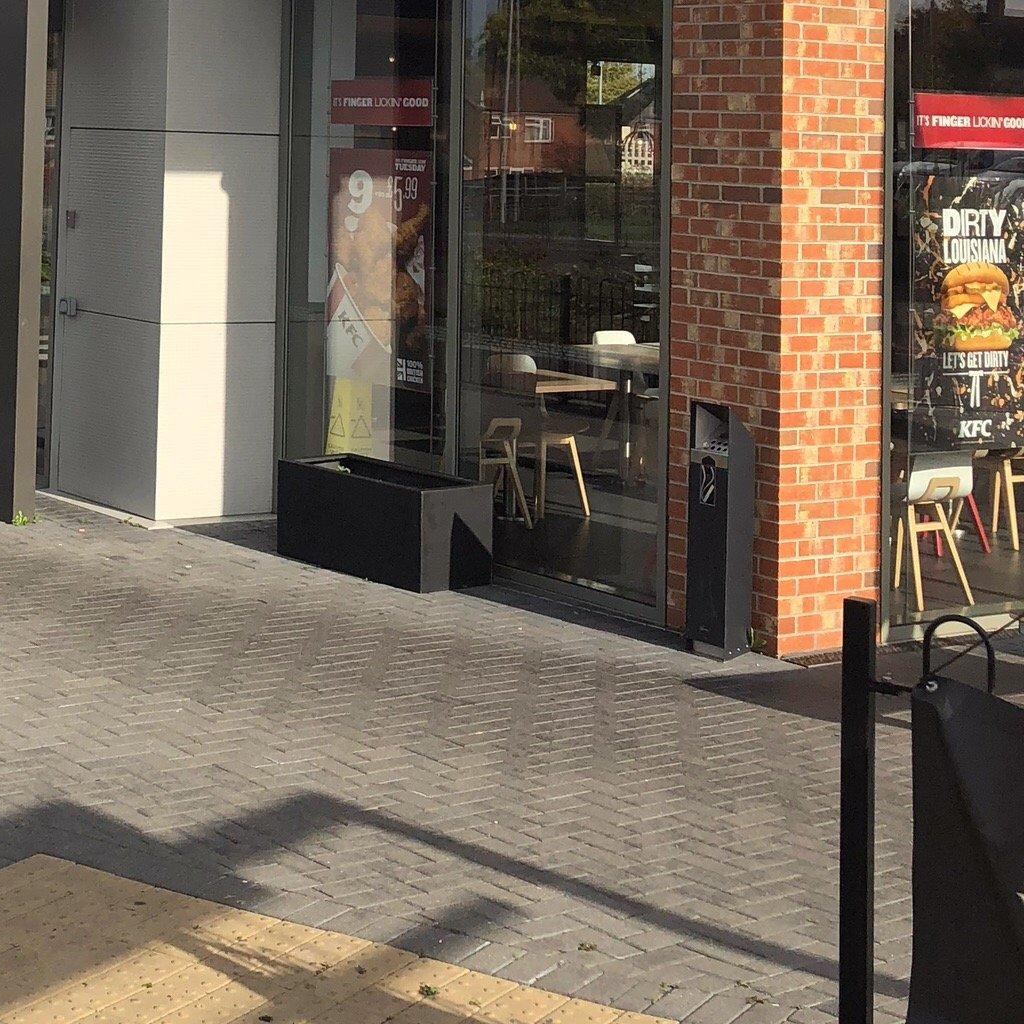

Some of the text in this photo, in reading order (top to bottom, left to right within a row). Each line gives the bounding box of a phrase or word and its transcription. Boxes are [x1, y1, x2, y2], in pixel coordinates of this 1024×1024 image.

[343, 97, 373, 108] FINGER
[403, 97, 429, 108] GOOD
[916, 115, 930, 127] IT'S
[931, 115, 971, 128] FINGER
[972, 116, 1003, 129] LICKIN'
[395, 163, 426, 172] TUESDAY
[942, 208, 1007, 237] DIRTY
[943, 238, 1007, 264] LOUISIANA
[942, 350, 1009, 369] LET'S GET DIRTY
[957, 419, 992, 438] KFC
